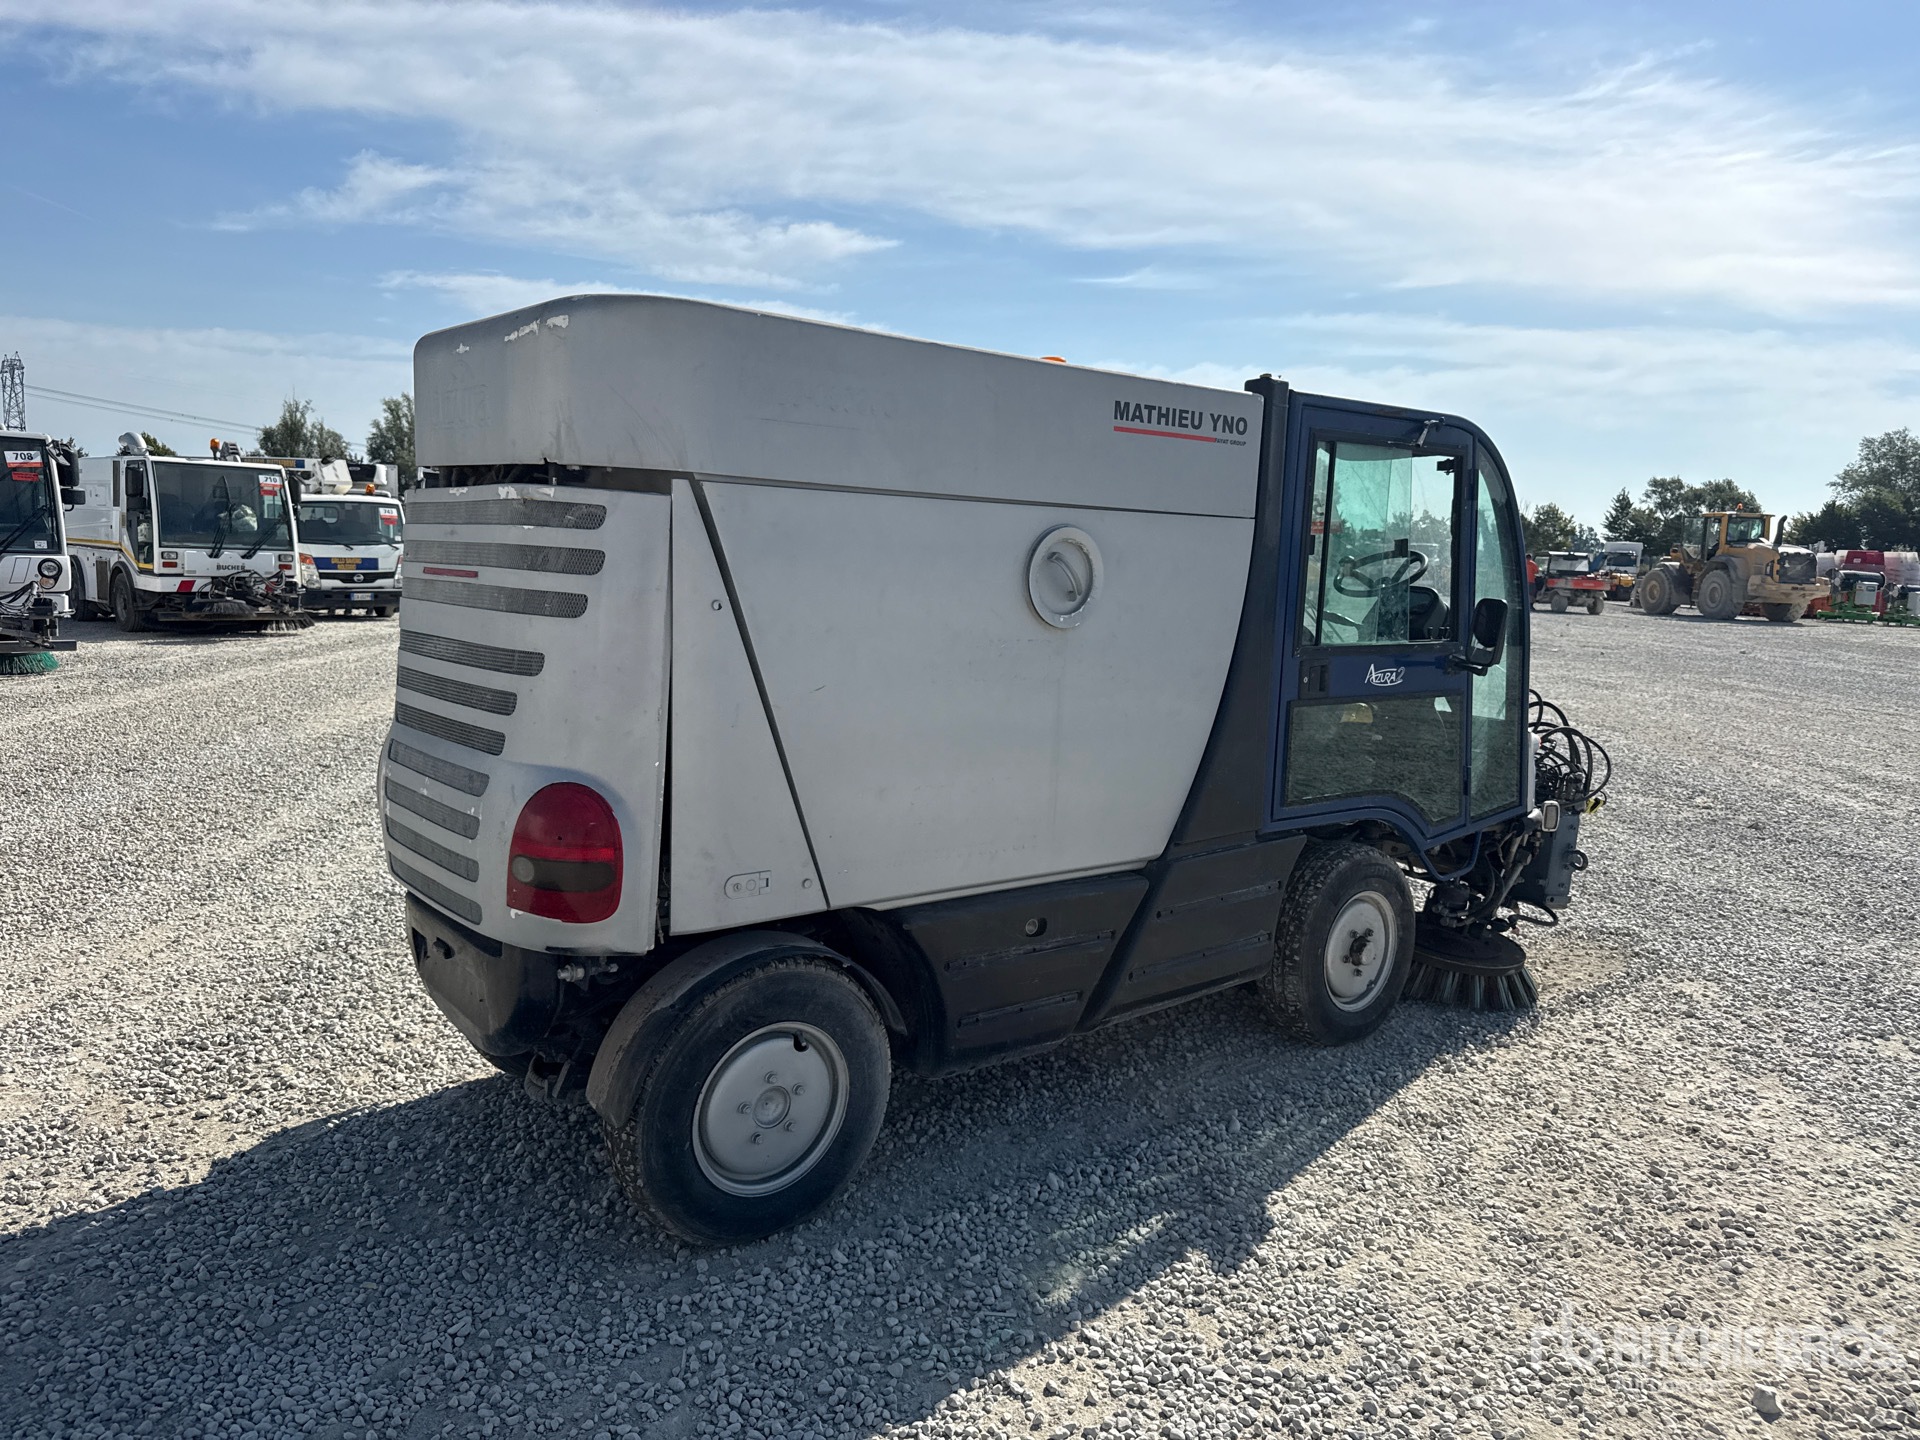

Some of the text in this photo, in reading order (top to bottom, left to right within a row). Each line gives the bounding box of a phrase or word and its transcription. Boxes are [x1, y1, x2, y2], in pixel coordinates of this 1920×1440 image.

[1114, 400, 1247, 435] MATHIEU YNO
[12, 452, 33, 460] 708
